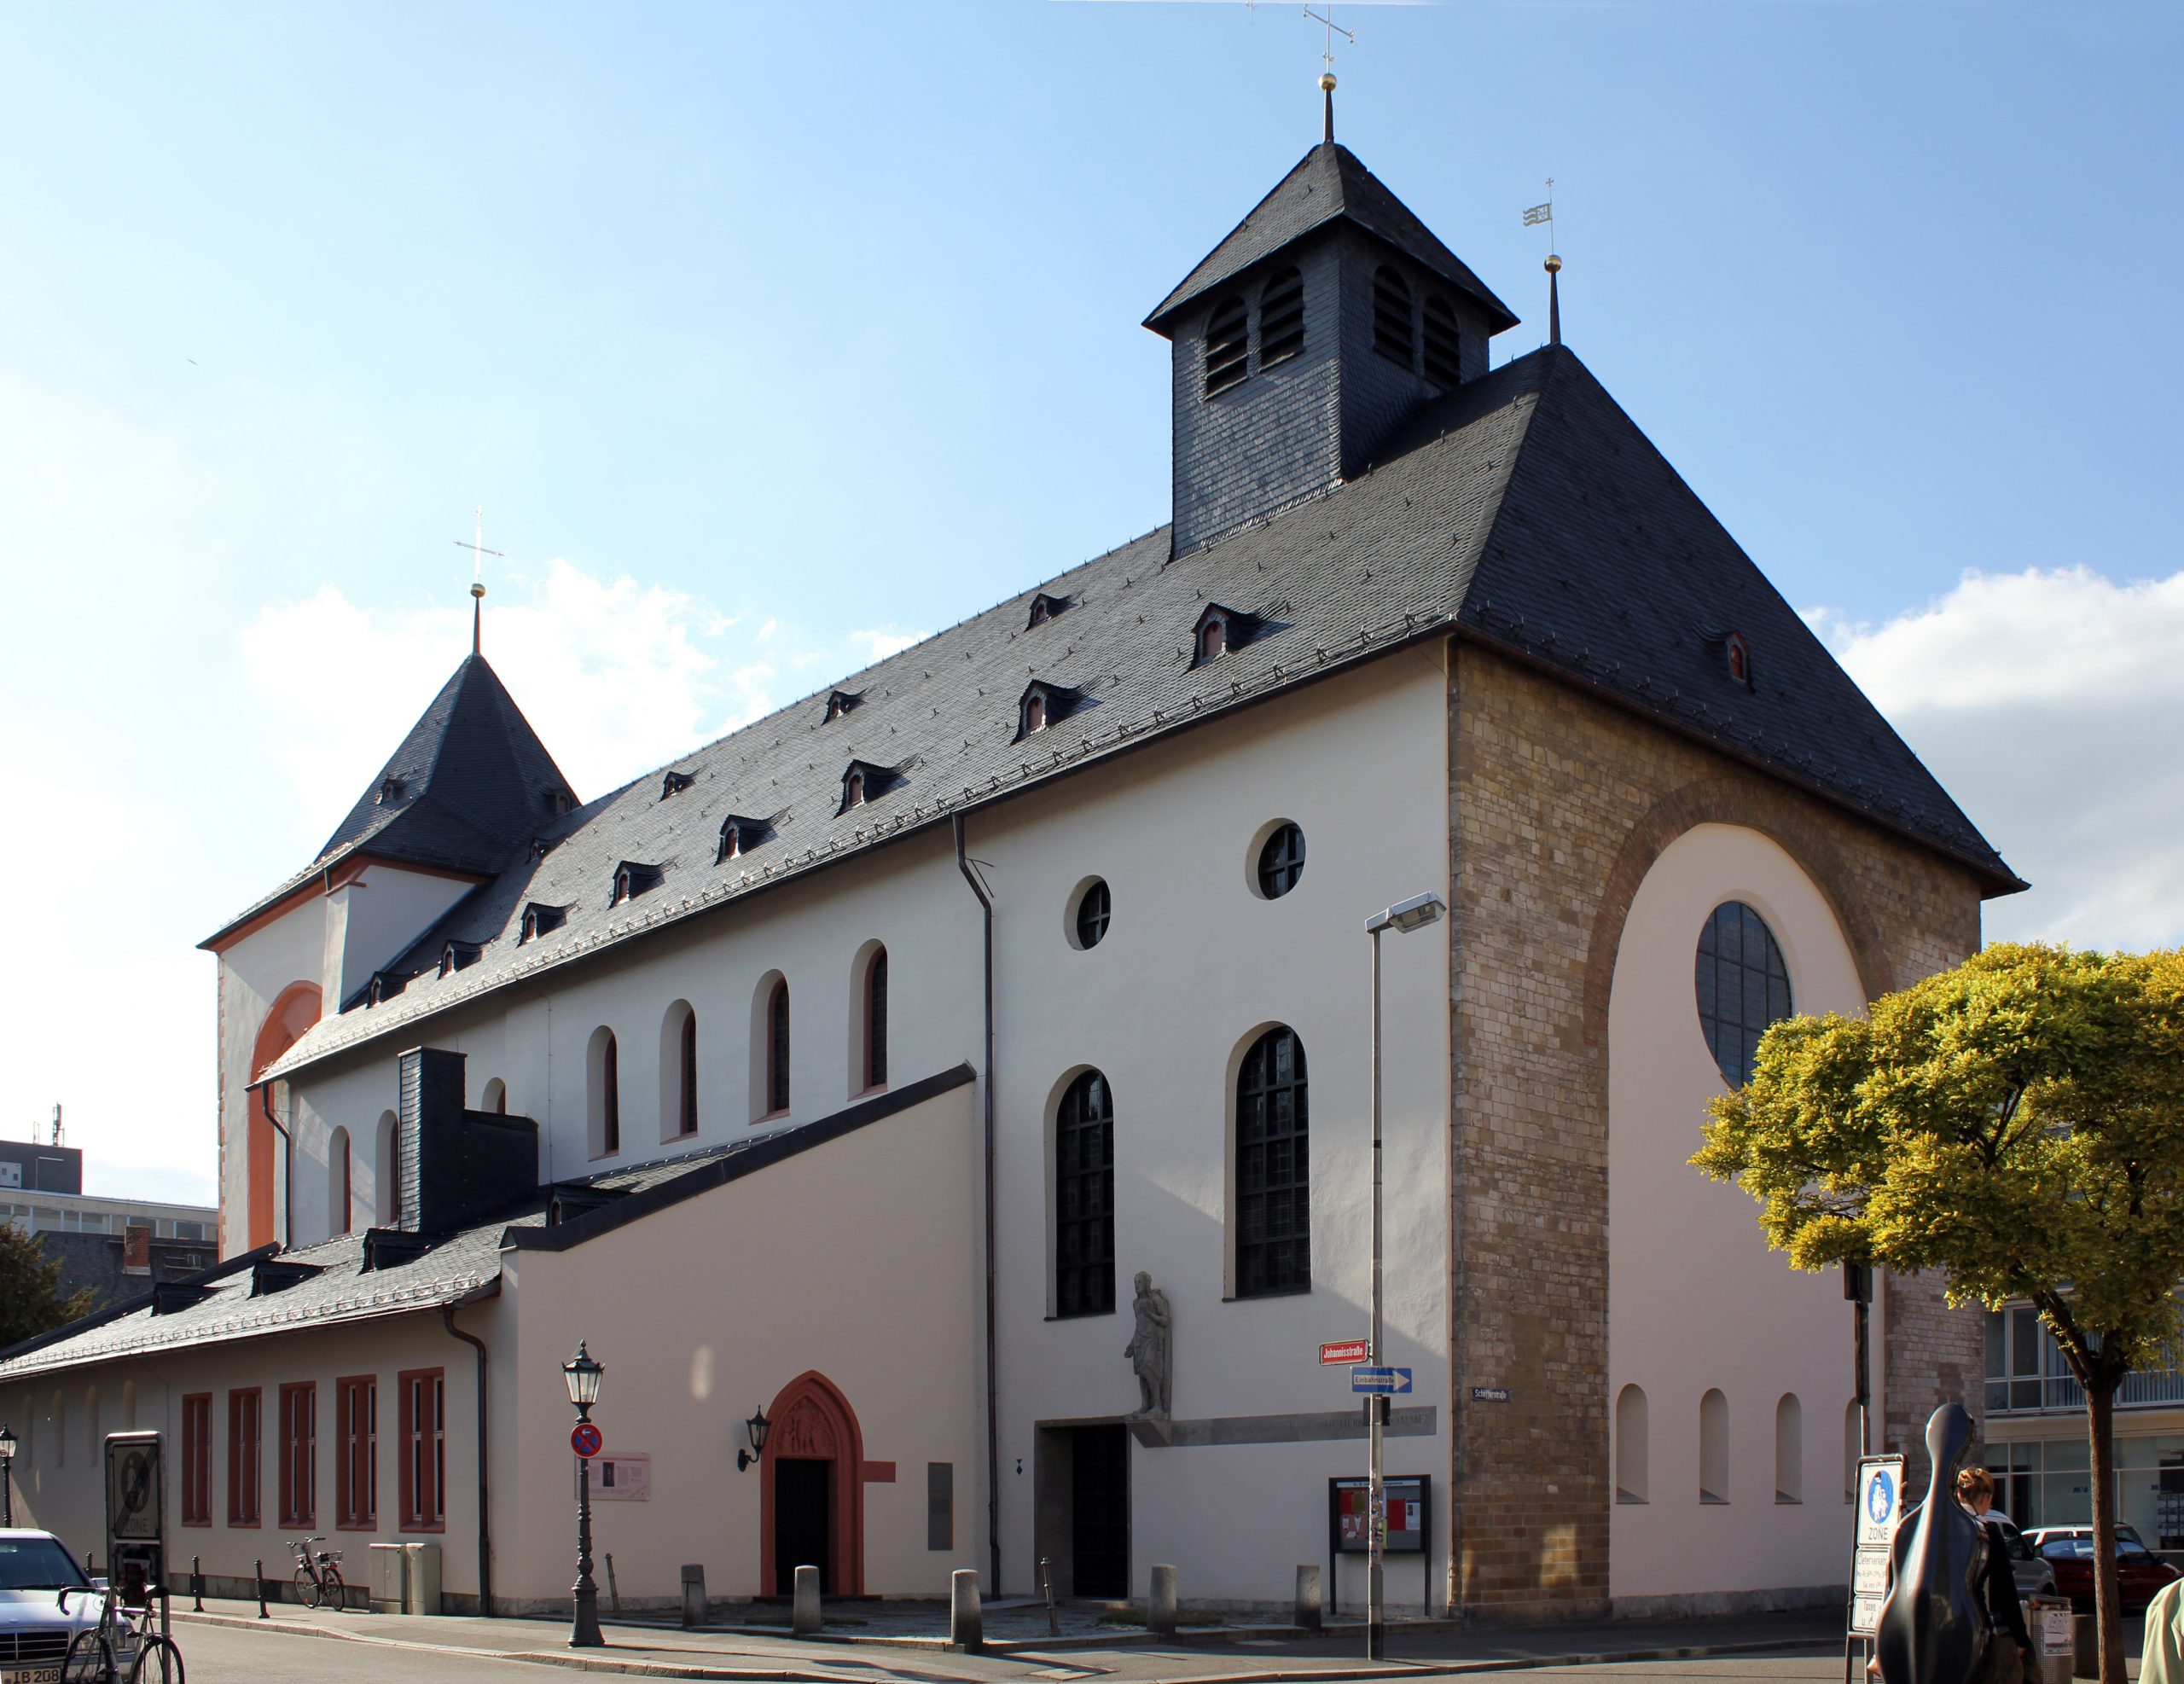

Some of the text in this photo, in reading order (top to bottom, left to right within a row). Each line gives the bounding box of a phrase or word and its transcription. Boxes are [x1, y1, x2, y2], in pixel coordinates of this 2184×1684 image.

[1324, 1345, 1362, 1358] Johannisstraße
[125, 1518, 148, 1533] ZONE
[1868, 1527, 1888, 1540] ZONE
[14, 1669, 60, 1684] IB 208
